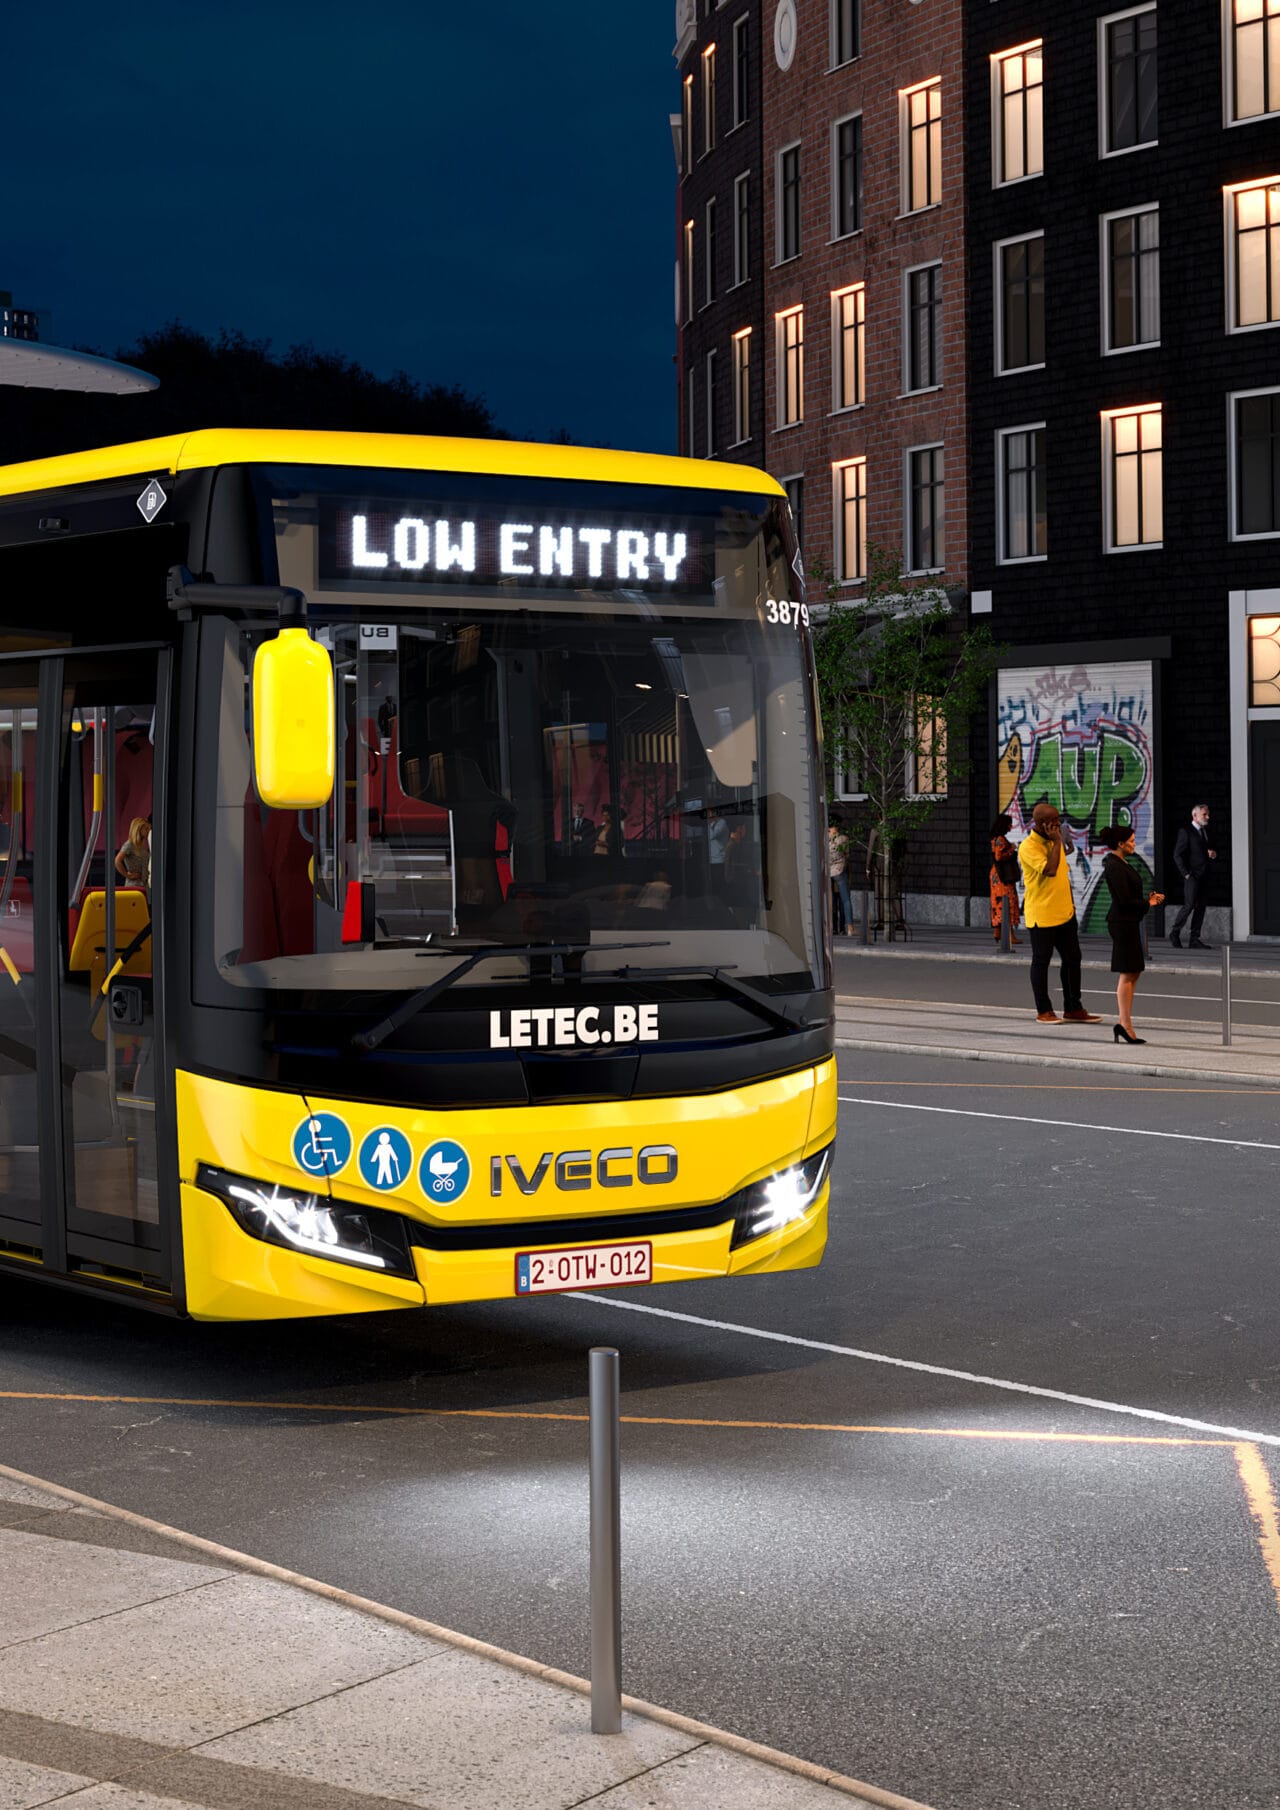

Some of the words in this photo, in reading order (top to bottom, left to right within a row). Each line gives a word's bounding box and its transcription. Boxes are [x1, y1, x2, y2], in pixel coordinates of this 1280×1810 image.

[352, 515, 476, 572] LOW
[500, 523, 687, 581] ENTRY
[765, 599, 810, 627] 3879
[489, 1003, 659, 1049] LETEC.BE
[489, 1143, 679, 1198] IVECO
[520, 1276, 528, 1287] B
